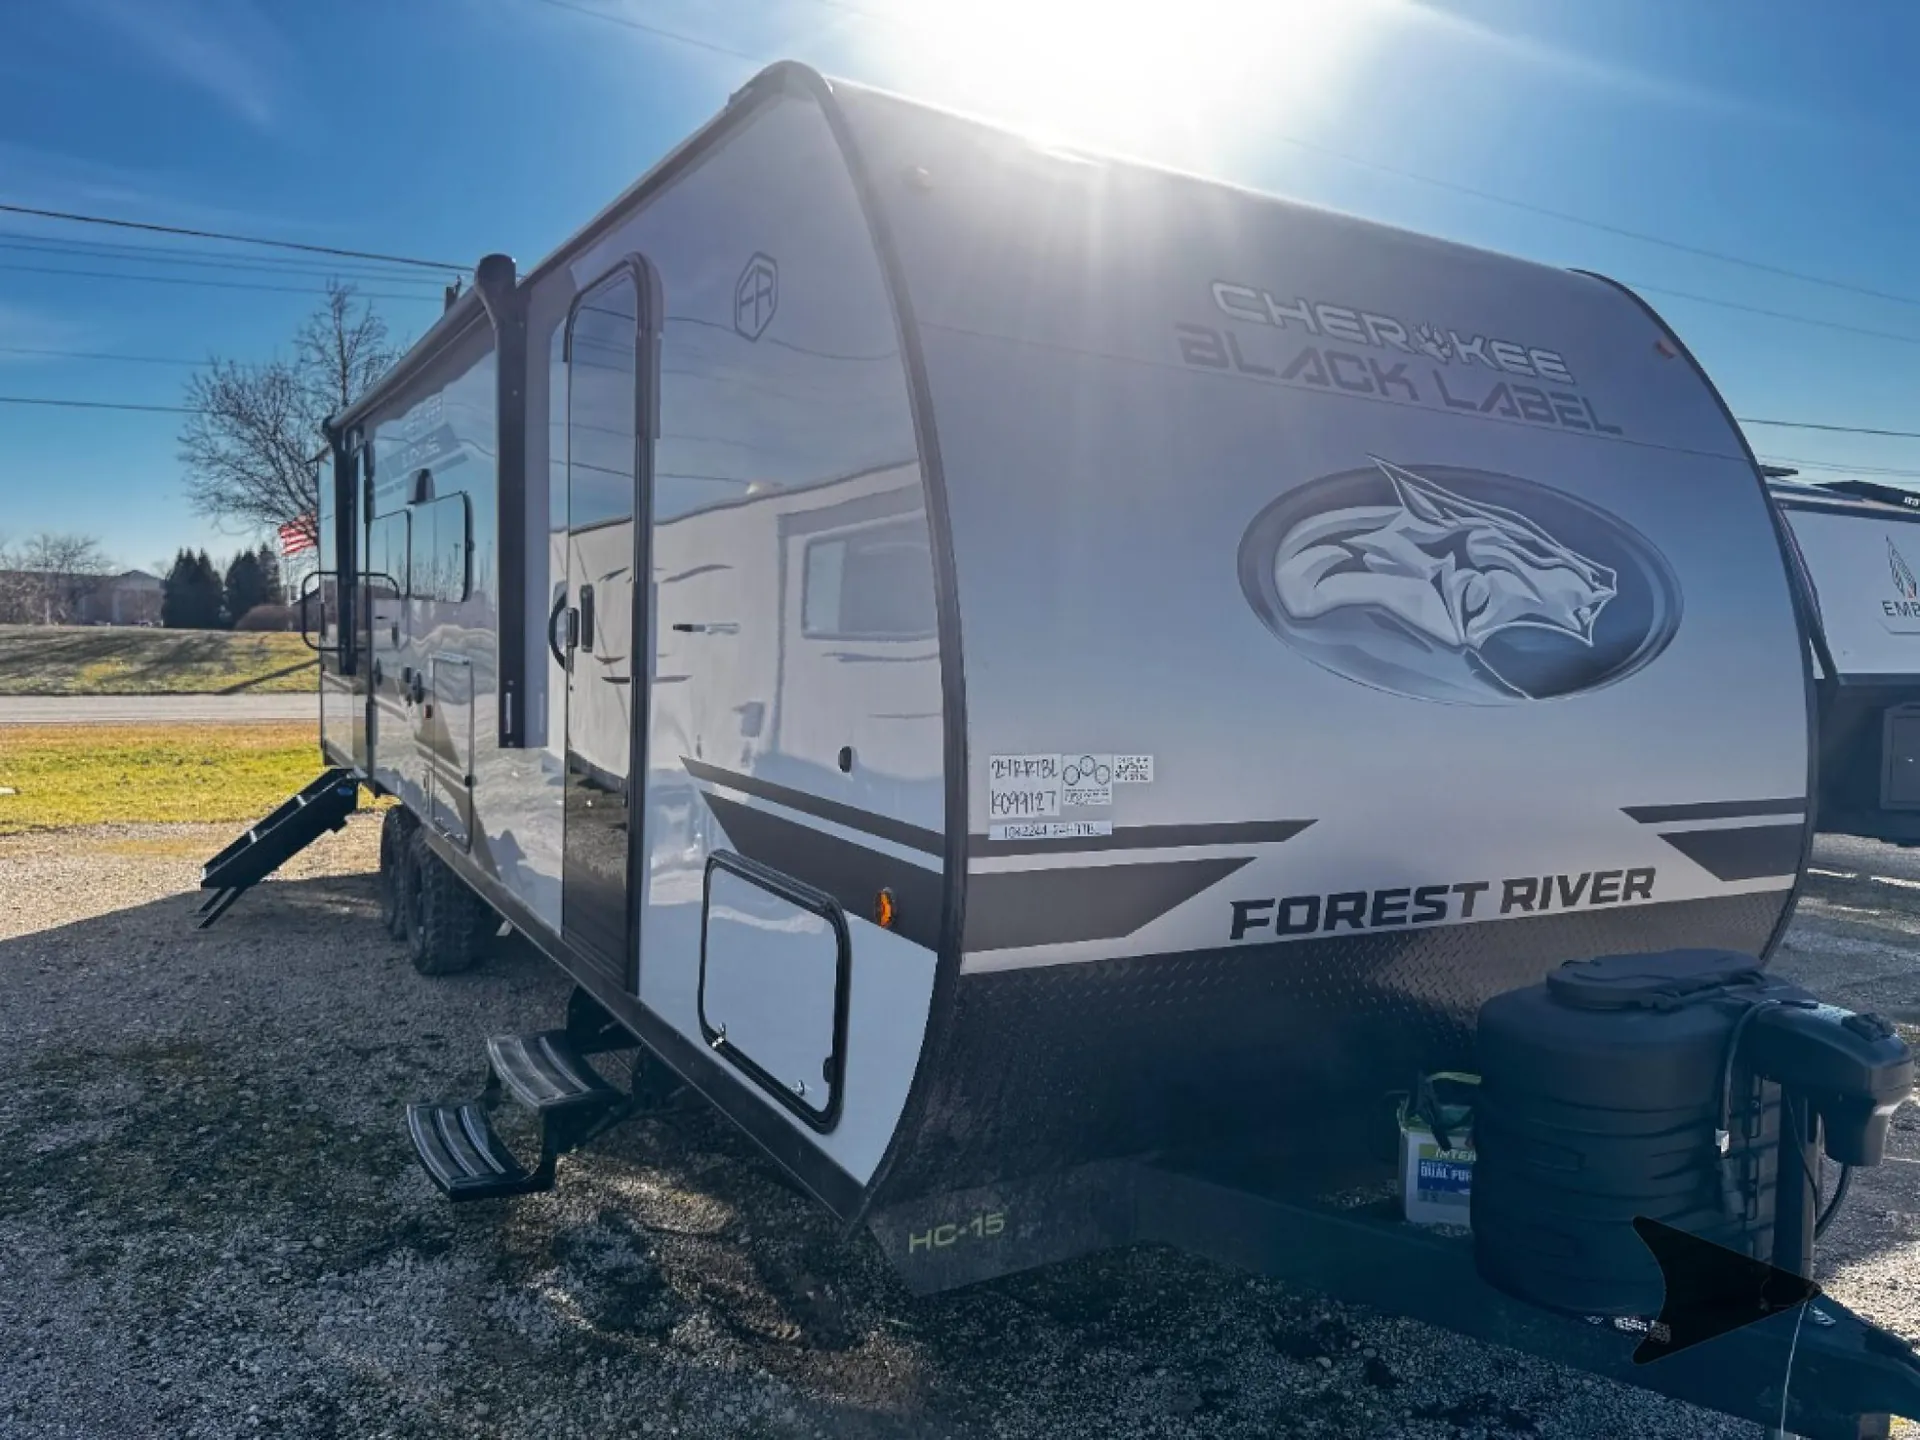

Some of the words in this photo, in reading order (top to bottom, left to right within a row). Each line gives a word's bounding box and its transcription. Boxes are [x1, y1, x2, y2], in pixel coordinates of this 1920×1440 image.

[1174, 321, 1419, 403] BLACK
[1432, 368, 1623, 436] LABEL
[1229, 881, 1490, 941] FOREST
[1500, 866, 1658, 915] RIVER
[908, 1212, 1006, 1254] HC-15
